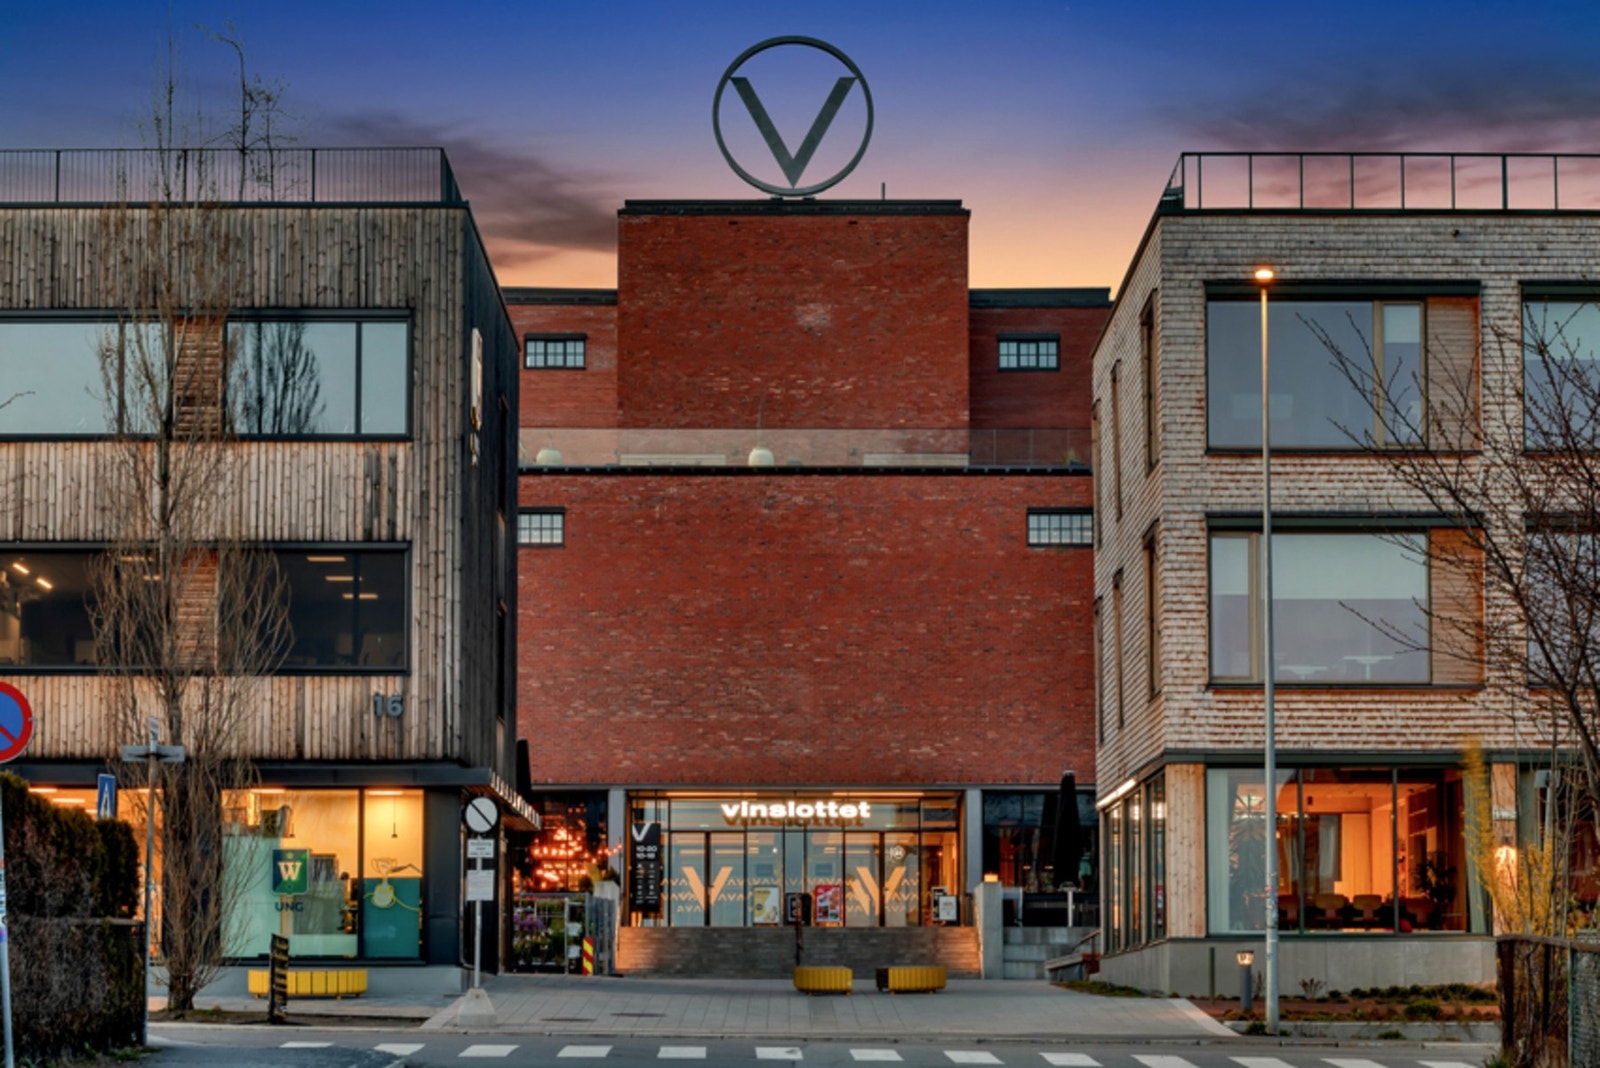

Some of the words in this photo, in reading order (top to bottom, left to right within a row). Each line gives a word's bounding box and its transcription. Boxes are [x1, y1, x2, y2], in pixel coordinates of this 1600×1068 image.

[729, 76, 857, 190] V
[373, 695, 404, 718] 16
[720, 800, 872, 819] vinslottet
[277, 861, 302, 881] W
[274, 901, 304, 912] UNG
